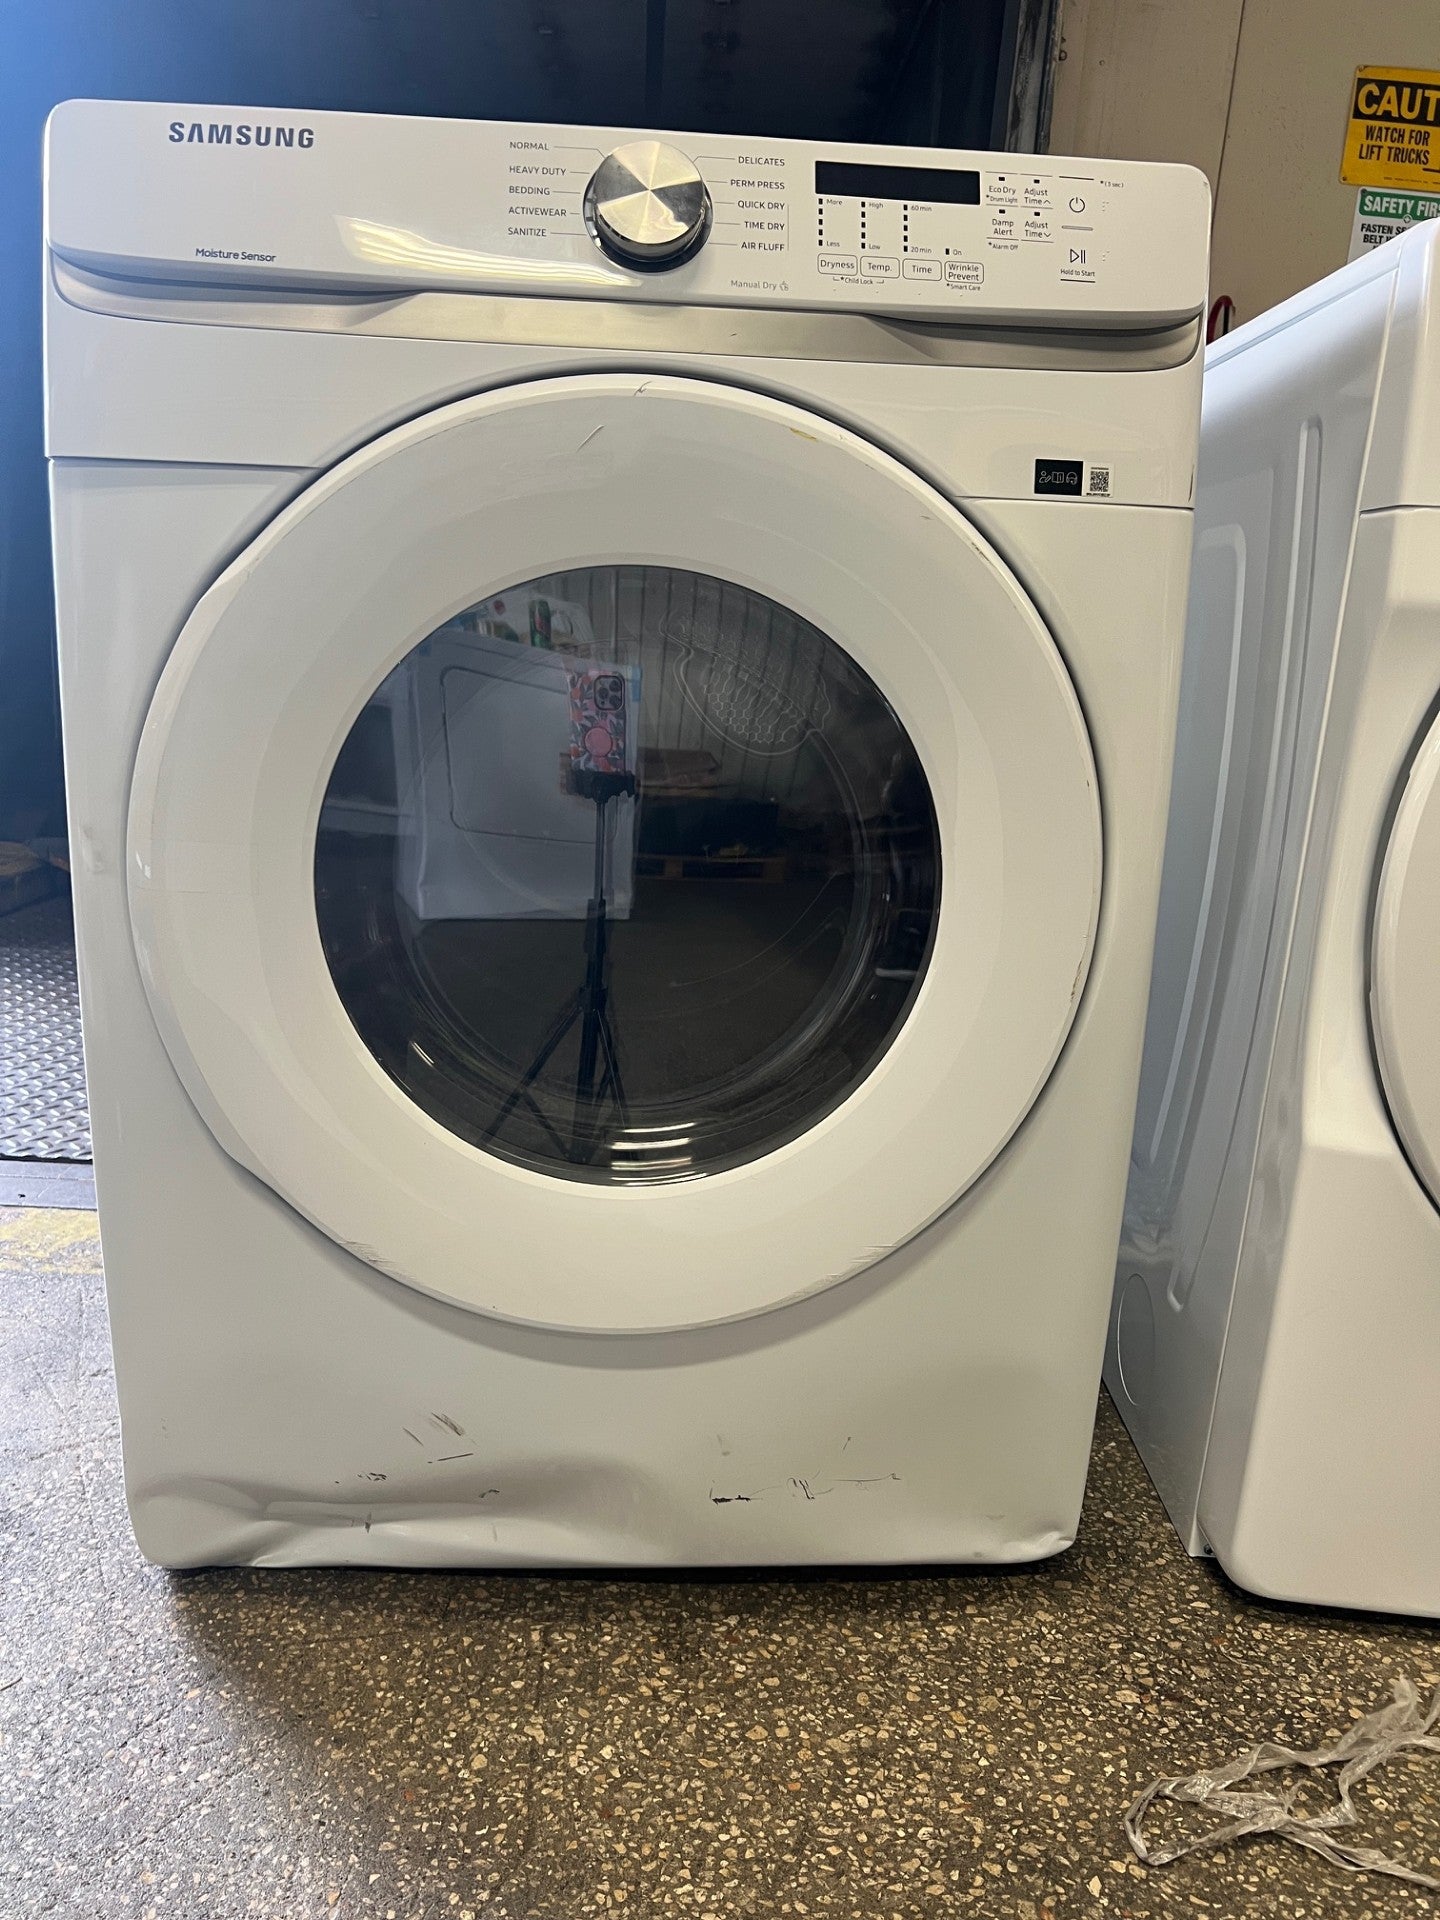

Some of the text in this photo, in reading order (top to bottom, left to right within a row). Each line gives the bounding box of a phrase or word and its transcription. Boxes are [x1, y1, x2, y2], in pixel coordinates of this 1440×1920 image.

[169, 122, 314, 148] SAMSUNG
[1365, 125, 1430, 146] WATCH FOR
[509, 141, 549, 151] NORMAL
[1358, 143, 1430, 166] LIFT TRUCKS
[738, 155, 785, 167] DELICATES
[509, 165, 566, 177] HEAVY DUTY
[730, 178, 785, 190] PERM PRESS
[508, 186, 550, 196] BEDDING
[989, 185, 1016, 196] Eco Dry
[1024, 187, 1048, 197] Adjust
[737, 200, 785, 211] QUICK DRY
[826, 198, 843, 206] More
[869, 202, 884, 210] High
[1024, 196, 1042, 205] Time
[1363, 195, 1415, 215] SAFETY
[508, 206, 567, 217] ACTIVEWEAR
[744, 221, 785, 231] TIME DRY
[992, 218, 1014, 229] Damp
[1024, 221, 1048, 231] Adjust
[1360, 223, 1394, 235] FASTEN
[507, 227, 547, 237] SANITIZE
[993, 228, 1013, 236] Alert
[1025, 230, 1043, 239] Time
[826, 240, 840, 248] Less
[1363, 234, 1384, 244] BELT
[741, 241, 785, 252] AIR FLUFF
[196, 248, 275, 262] Moisture Sensor
[820, 259, 855, 271] Dryness
[868, 262, 892, 273] Temp.
[912, 264, 932, 274] Time
[949, 263, 979, 273] Wrinkle
[948, 271, 979, 282] Prevent
[1060, 268, 1096, 278] Hold to Start
[730, 279, 777, 292] Manual Dry
[861, 277, 873, 285] Lock
